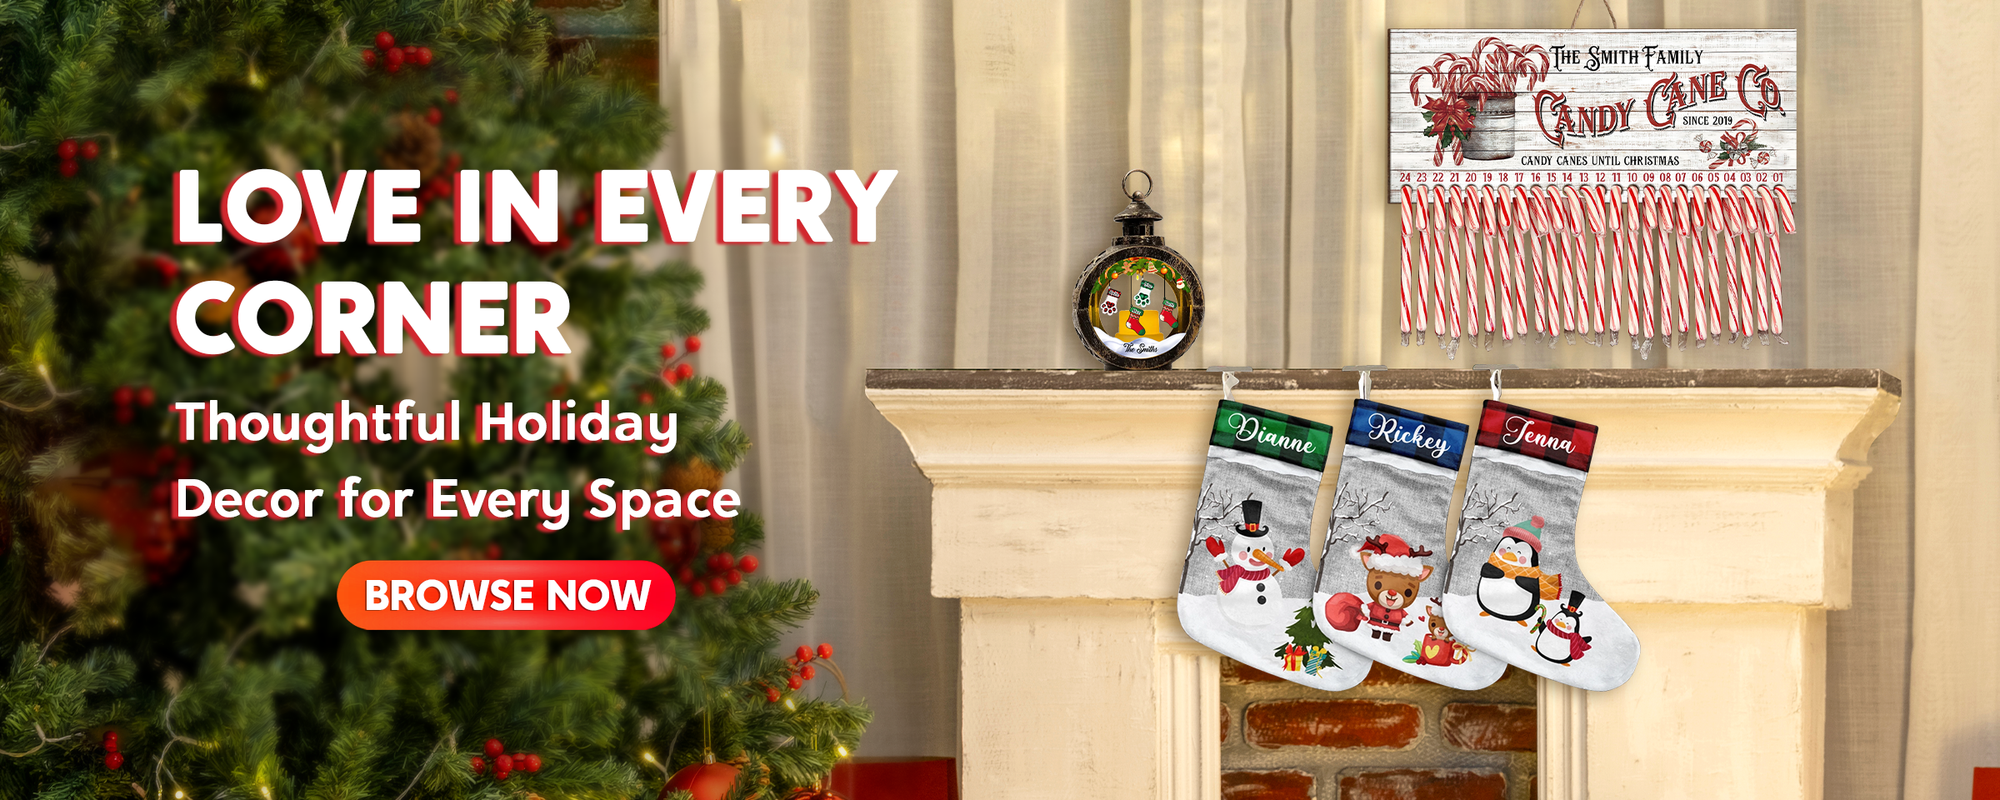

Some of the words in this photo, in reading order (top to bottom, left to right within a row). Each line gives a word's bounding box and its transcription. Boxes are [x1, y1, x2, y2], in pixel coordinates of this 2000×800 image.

[1549, 44, 1581, 72] THE
[1583, 45, 1639, 72] SMITH
[1641, 44, 1704, 72] FAMILY
[1532, 89, 1635, 149] CANDY
[1643, 71, 1727, 130] CANE
[1682, 116, 1710, 126] SINCE
[1712, 116, 1733, 126] 2019
[1400, 172, 1411, 183] 24
[1416, 172, 1427, 183] 23
[1433, 172, 1444, 183] 22
[1450, 172, 1460, 183] 21
[1465, 172, 1477, 183] 20
[1482, 172, 1493, 183] 19
[1499, 172, 1509, 183] 18
[1515, 172, 1525, 183] 17
[1531, 172, 1541, 183] 16
[1547, 172, 1557, 183] 15
[1563, 172, 1573, 183] 14
[1580, 172, 1589, 183] 13
[1596, 172, 1606, 183] 12
[1612, 172, 1621, 183] 11
[1628, 172, 1638, 183] 10
[1643, 172, 1655, 183] 09
[1659, 172, 1672, 183] 08
[1675, 172, 1687, 183] 07
[1692, 172, 1704, 183] 06
[1708, 172, 1720, 183] 05
[1724, 172, 1736, 183] 04
[1740, 172, 1752, 183] 03
[1756, 172, 1768, 183] 02
[1773, 172, 1783, 183] 01
[1520, 155, 1553, 167] CANDY
[1556, 155, 1589, 167] CANES
[1591, 155, 1621, 167] UNTIL
[1623, 155, 1681, 167] CHRISTMAS
[1228, 413, 1317, 455] Dianne
[1367, 412, 1451, 459] Rickey
[1502, 415, 1576, 455] Jenna
